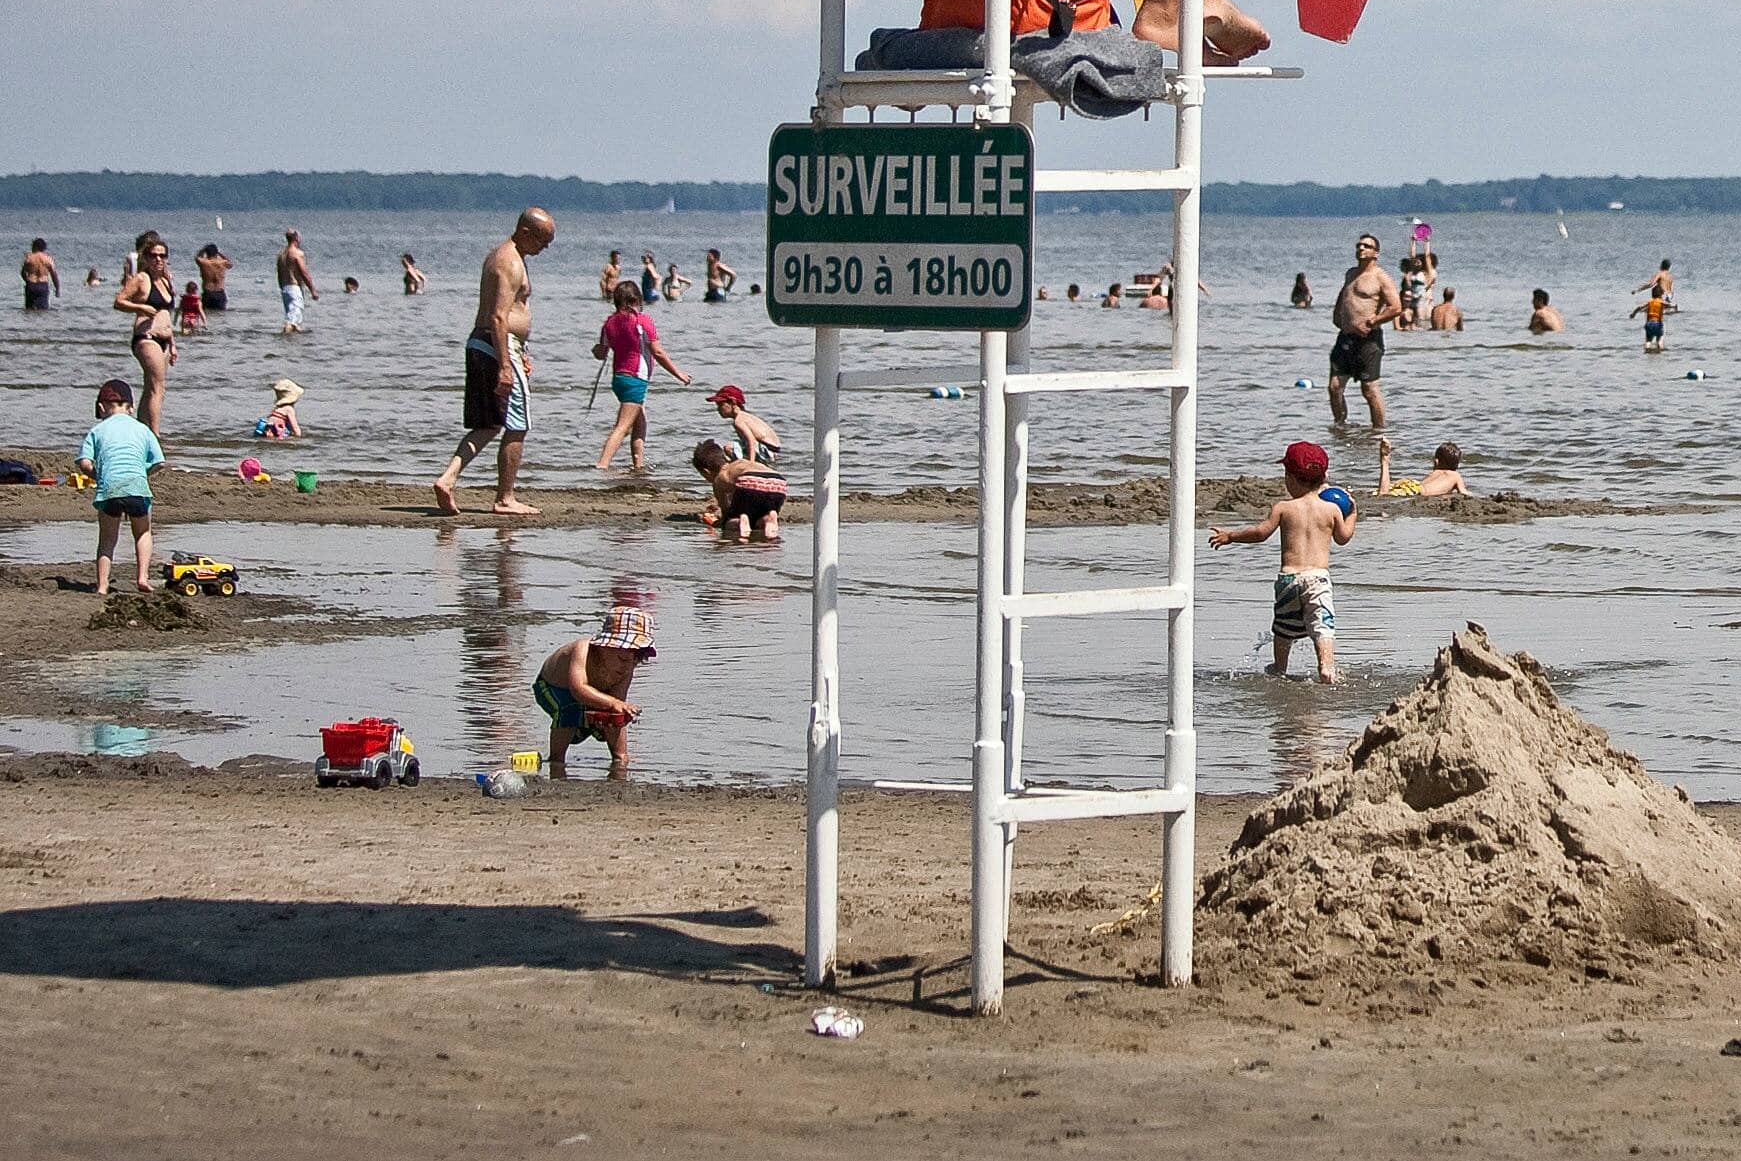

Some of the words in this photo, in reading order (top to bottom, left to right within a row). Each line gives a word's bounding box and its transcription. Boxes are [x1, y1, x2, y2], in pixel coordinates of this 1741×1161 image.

[775, 140, 1025, 216] SURVEILLÉE
[784, 254, 863, 294] 9h30
[874, 255, 893, 295] à
[907, 255, 1012, 296] 18h00
